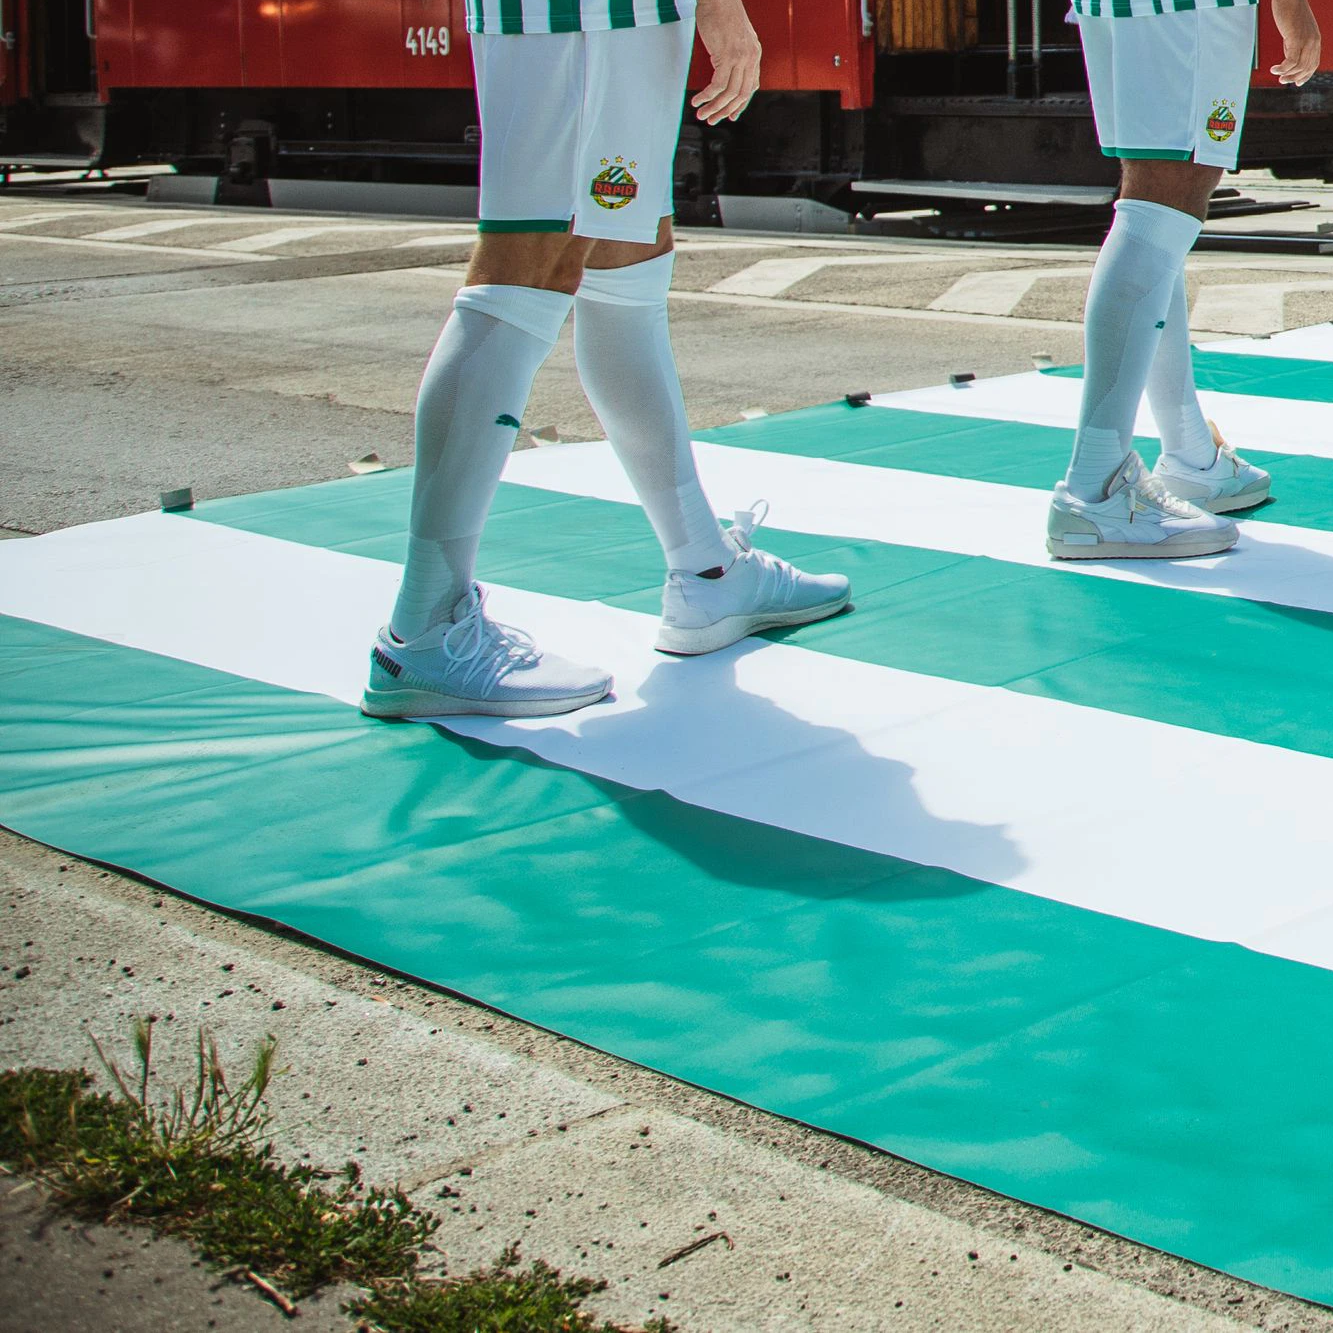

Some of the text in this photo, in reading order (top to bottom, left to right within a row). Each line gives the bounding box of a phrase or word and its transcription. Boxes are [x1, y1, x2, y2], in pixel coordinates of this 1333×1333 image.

[405, 26, 450, 56] 4149
[594, 181, 635, 196] RAPID
[372, 646, 403, 678] PUMA
